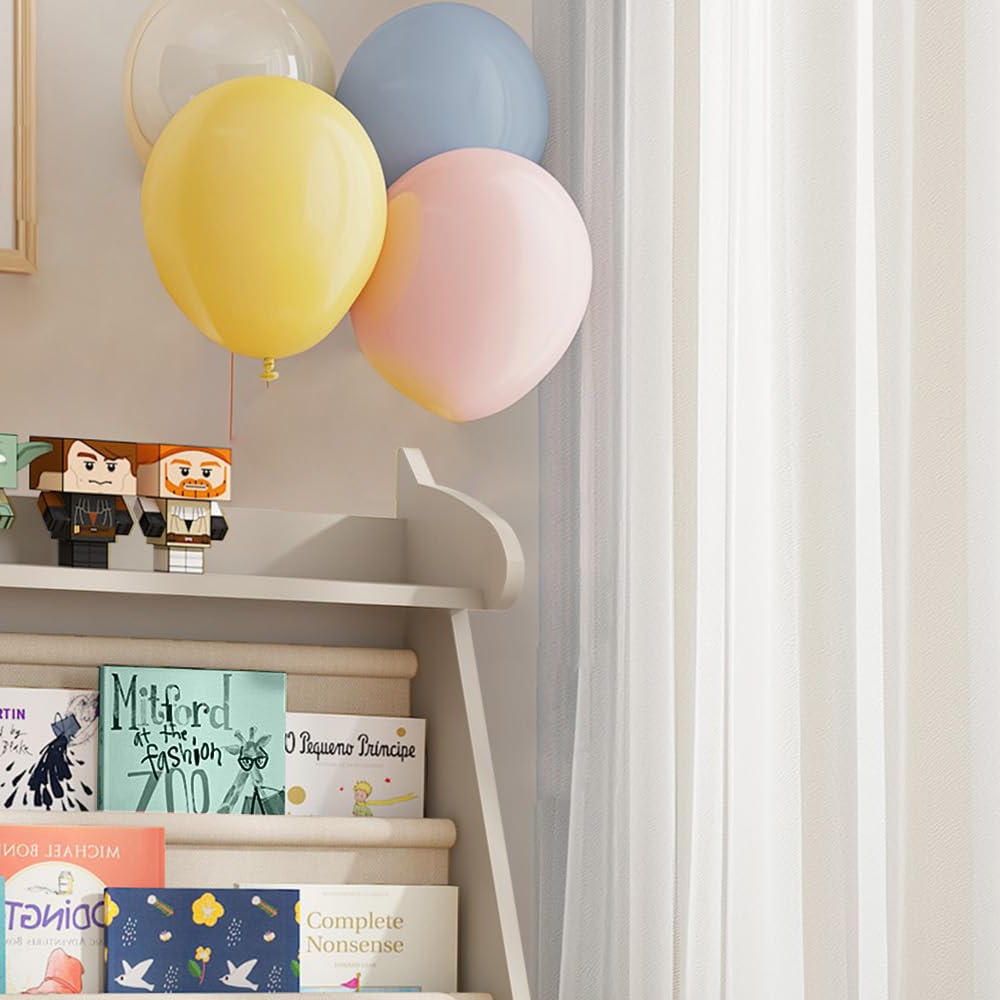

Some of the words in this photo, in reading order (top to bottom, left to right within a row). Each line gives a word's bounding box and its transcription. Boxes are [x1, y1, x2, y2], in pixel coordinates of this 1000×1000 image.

[110, 672, 233, 731] Mitford
[133, 730, 151, 747] at
[159, 723, 188, 743] the
[299, 731, 354, 760] Pequeno
[141, 736, 222, 781] fashion
[306, 911, 404, 934] Complete
[306, 935, 405, 954] Nonsense
